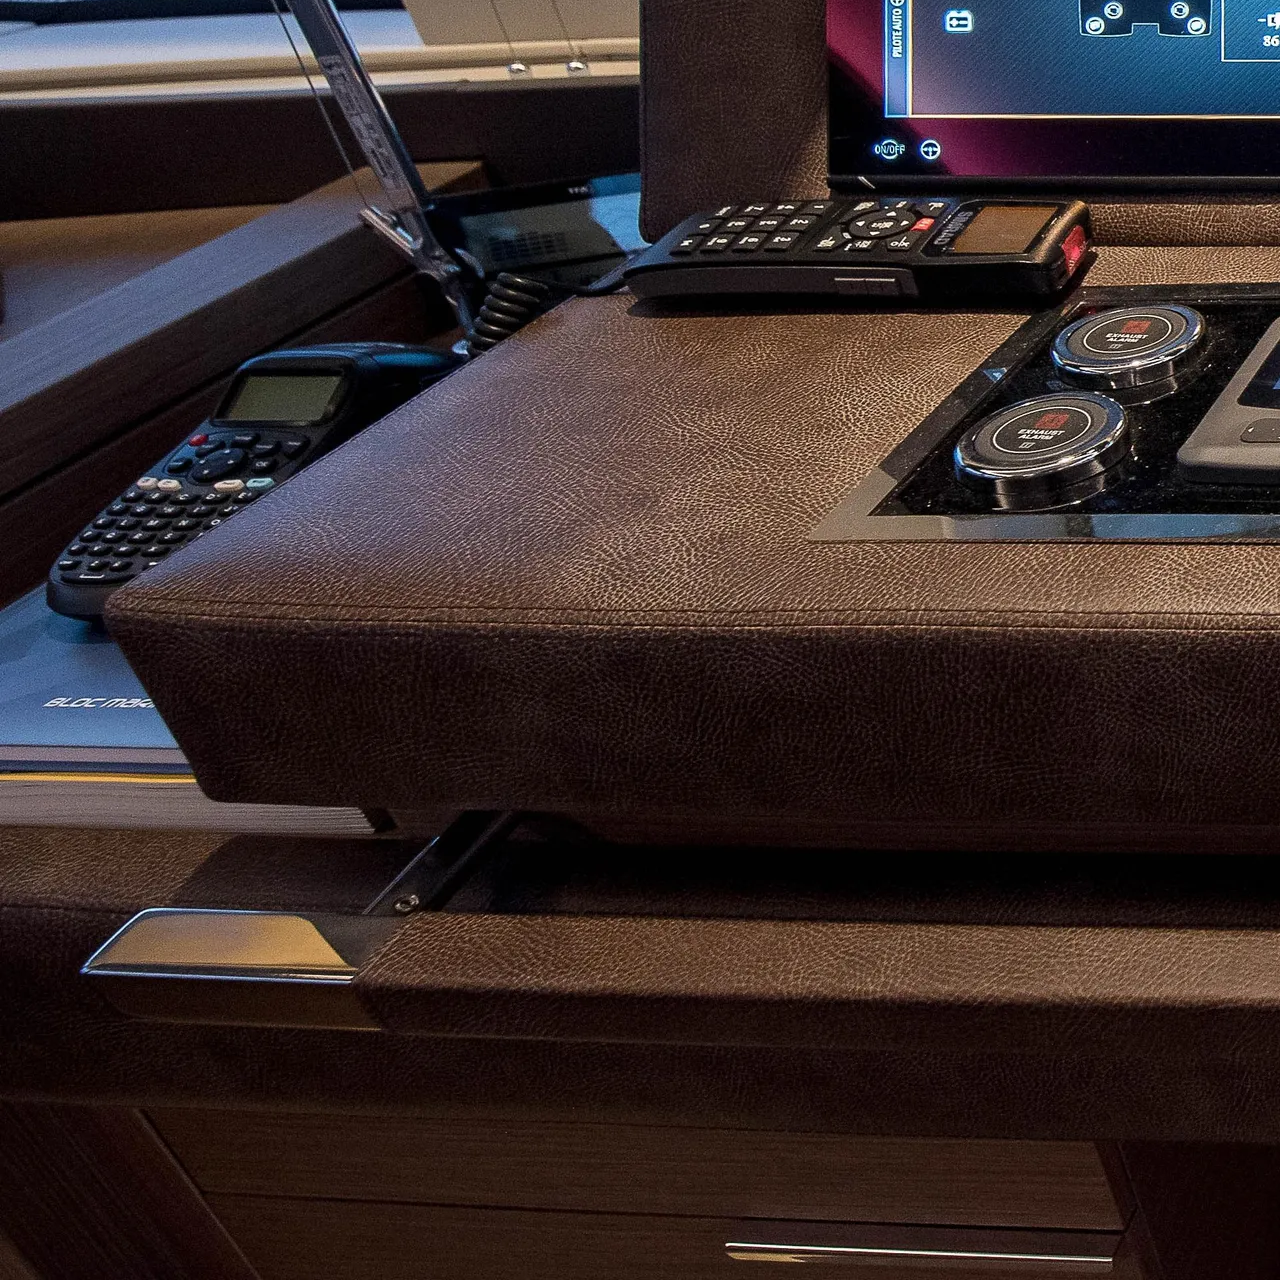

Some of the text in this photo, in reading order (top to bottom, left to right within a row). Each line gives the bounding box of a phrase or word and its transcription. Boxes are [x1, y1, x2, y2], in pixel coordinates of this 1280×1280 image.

[892, 8, 902, 58] PILOTE AUTO
[43, 697, 106, 708] BLOC
